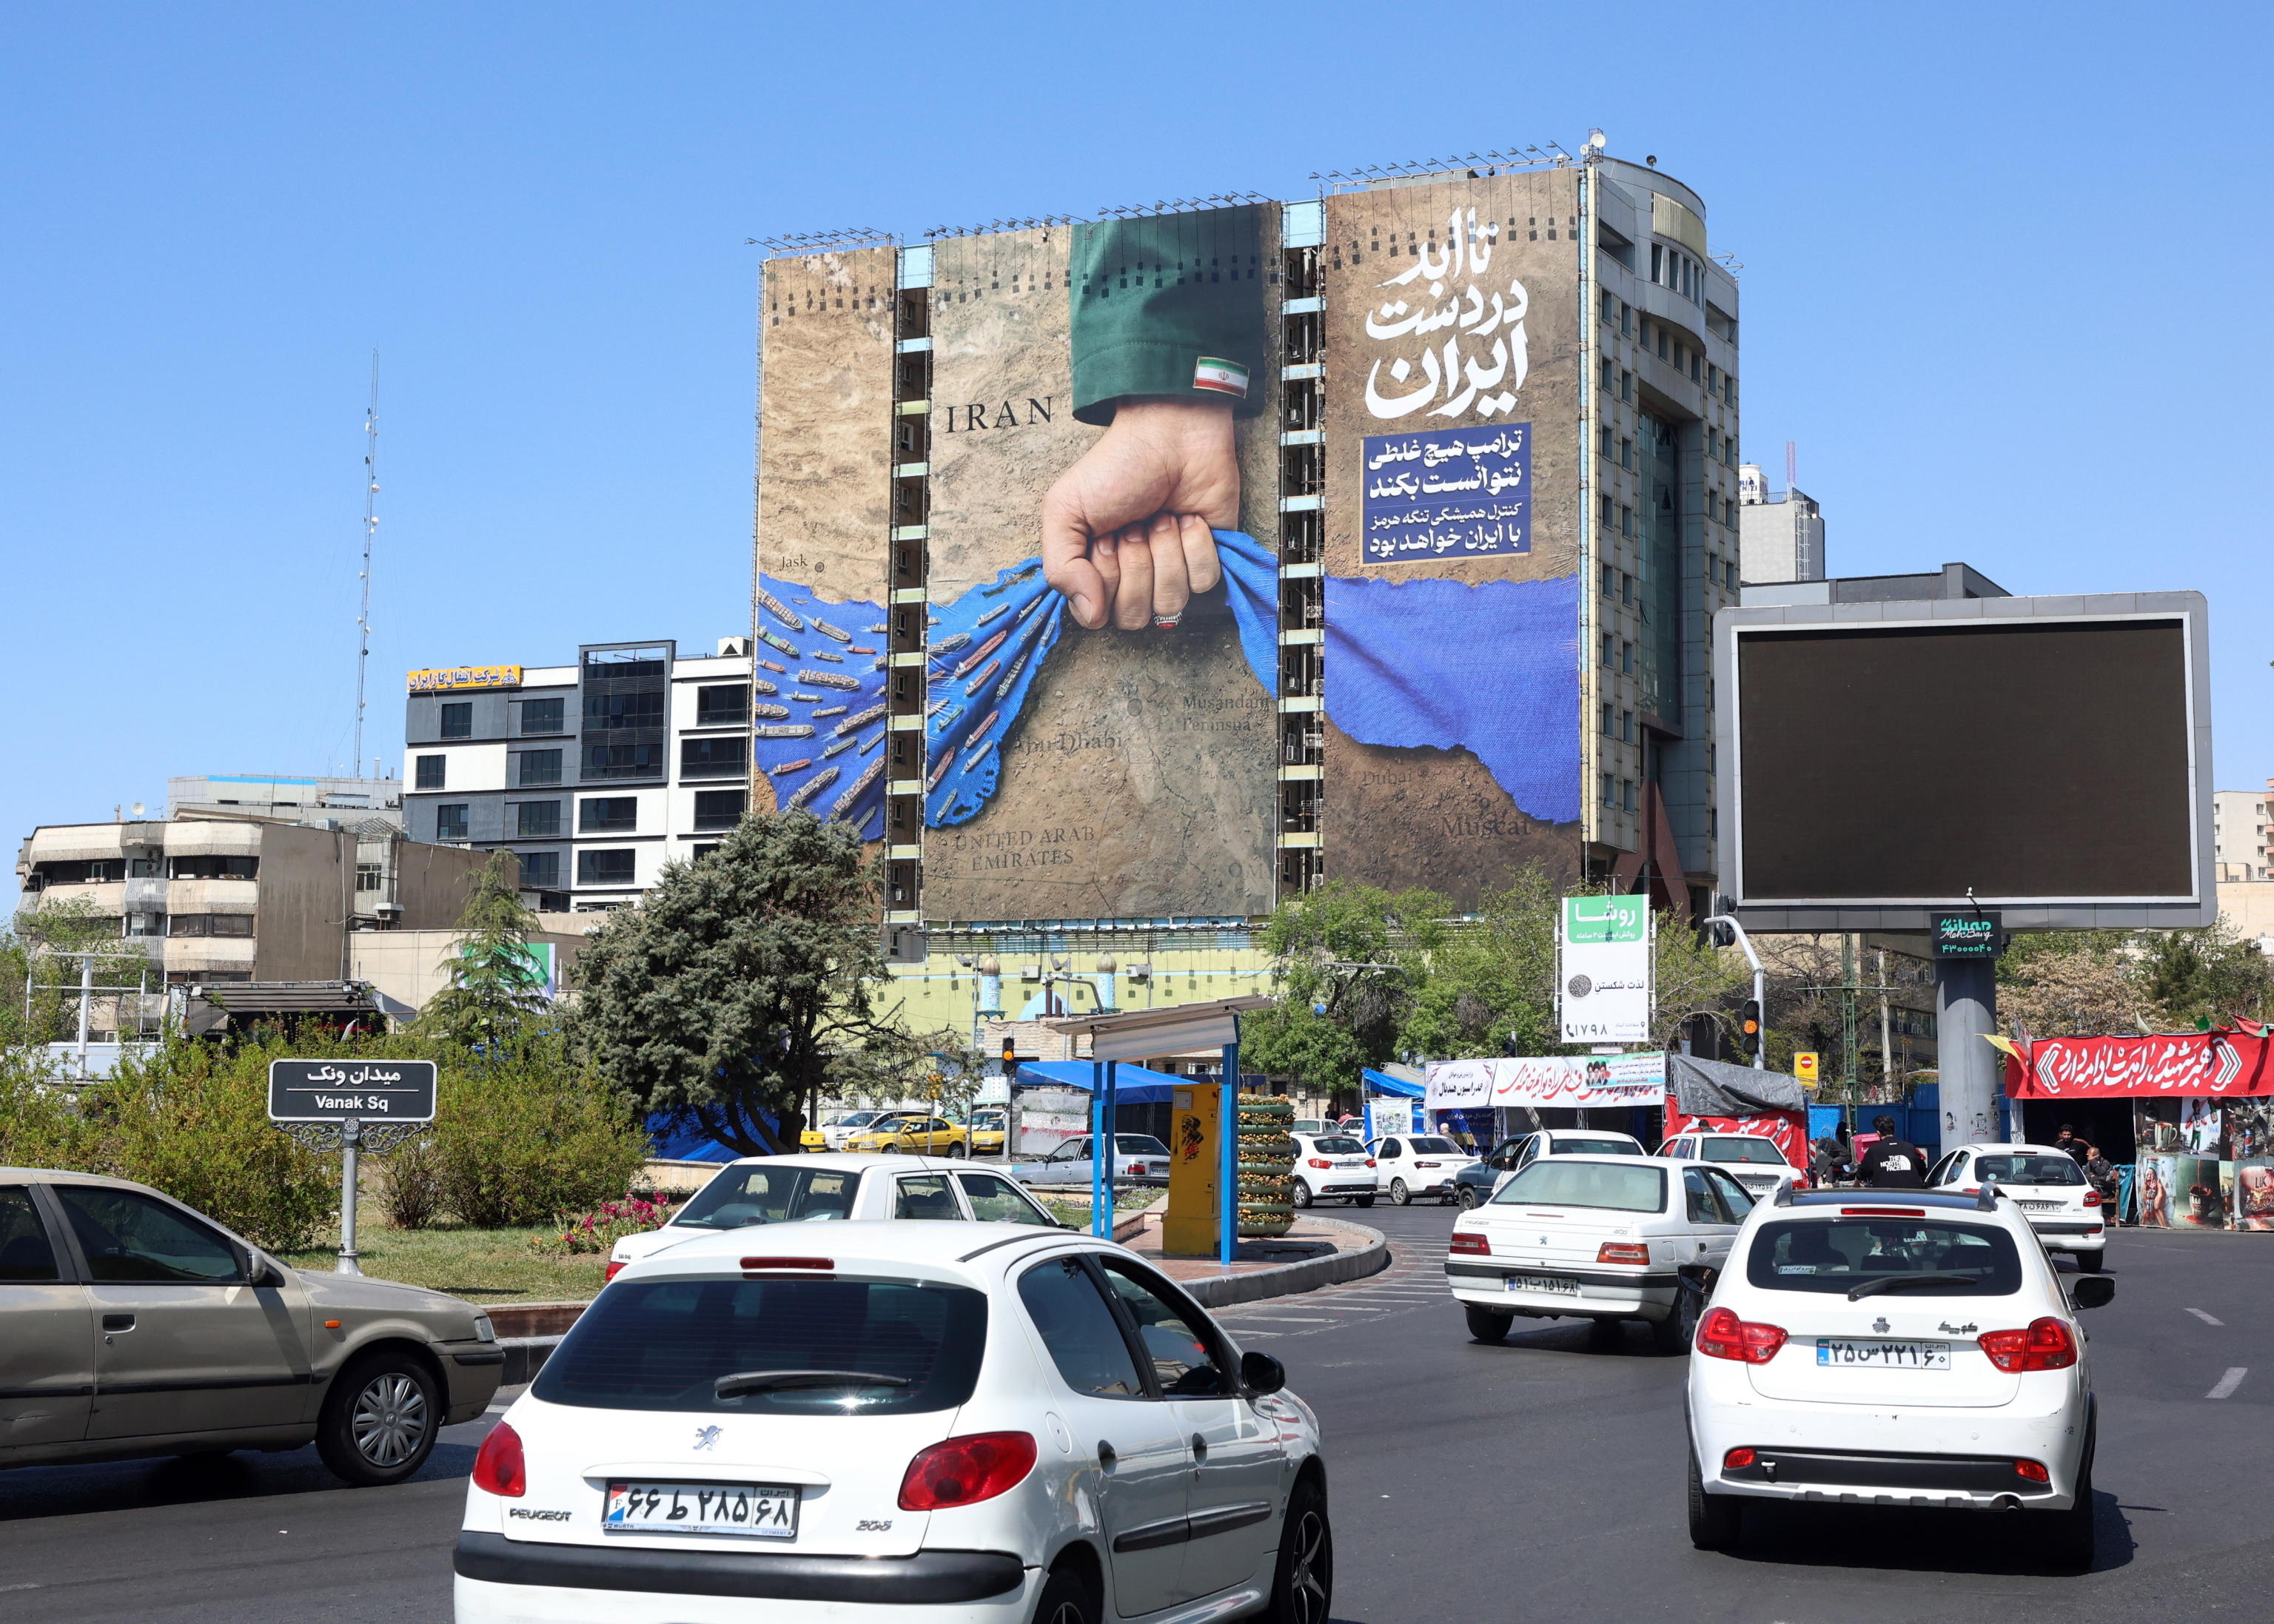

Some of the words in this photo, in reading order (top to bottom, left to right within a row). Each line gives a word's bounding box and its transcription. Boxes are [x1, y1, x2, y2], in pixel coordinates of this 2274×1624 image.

[1466, 207, 1500, 274] تا
[1365, 319, 1529, 419] ایران
[945, 395, 1054, 434] IRAN
[1369, 439, 1421, 470] غلطی
[1423, 439, 1465, 468] هیچ
[1466, 429, 1523, 463] ترامپ
[1369, 472, 1419, 501] بکند
[1422, 461, 1523, 496] نتوانست
[1402, 509, 1429, 524] تنگه
[1430, 507, 1486, 526] همیشگی
[1487, 503, 1523, 521] کنترل
[1369, 515, 1400, 531] هرمز
[1399, 527, 1462, 554] خواهد
[1465, 522, 1504, 551] ایران
[1507, 523, 1521, 548] با
[1369, 537, 1396, 558] بود
[779, 554, 808, 571] Jask
[409, 673, 432, 689] ایران
[446, 669, 472, 686] انتقال
[474, 668, 500, 684] شرکت
[1443, 816, 1532, 836] Muscat
[955, 831, 1033, 850] UNITED
[1039, 826, 1095, 844] ARAB
[972, 849, 1074, 871] EMIRATES
[1575, 900, 1636, 927] روشا
[1628, 980, 1644, 989] لذت
[1575, 1024, 1608, 1036] ۱۷۹۸
[307, 1065, 347, 1086] ونک
[349, 1066, 401, 1085] میدان
[1439, 1081, 1457, 1097] هندبال
[1457, 1079, 1483, 1096] فدراسیون
[315, 1095, 363, 1110] Vanak
[367, 1095, 389, 1112] Sq
[760, 1489, 789, 1497] ایران
[615, 1499, 623, 1509] F
[755, 1499, 788, 1526] ۶۸
[509, 1507, 572, 1522] PEUGEOT
[856, 1520, 893, 1531] 206
